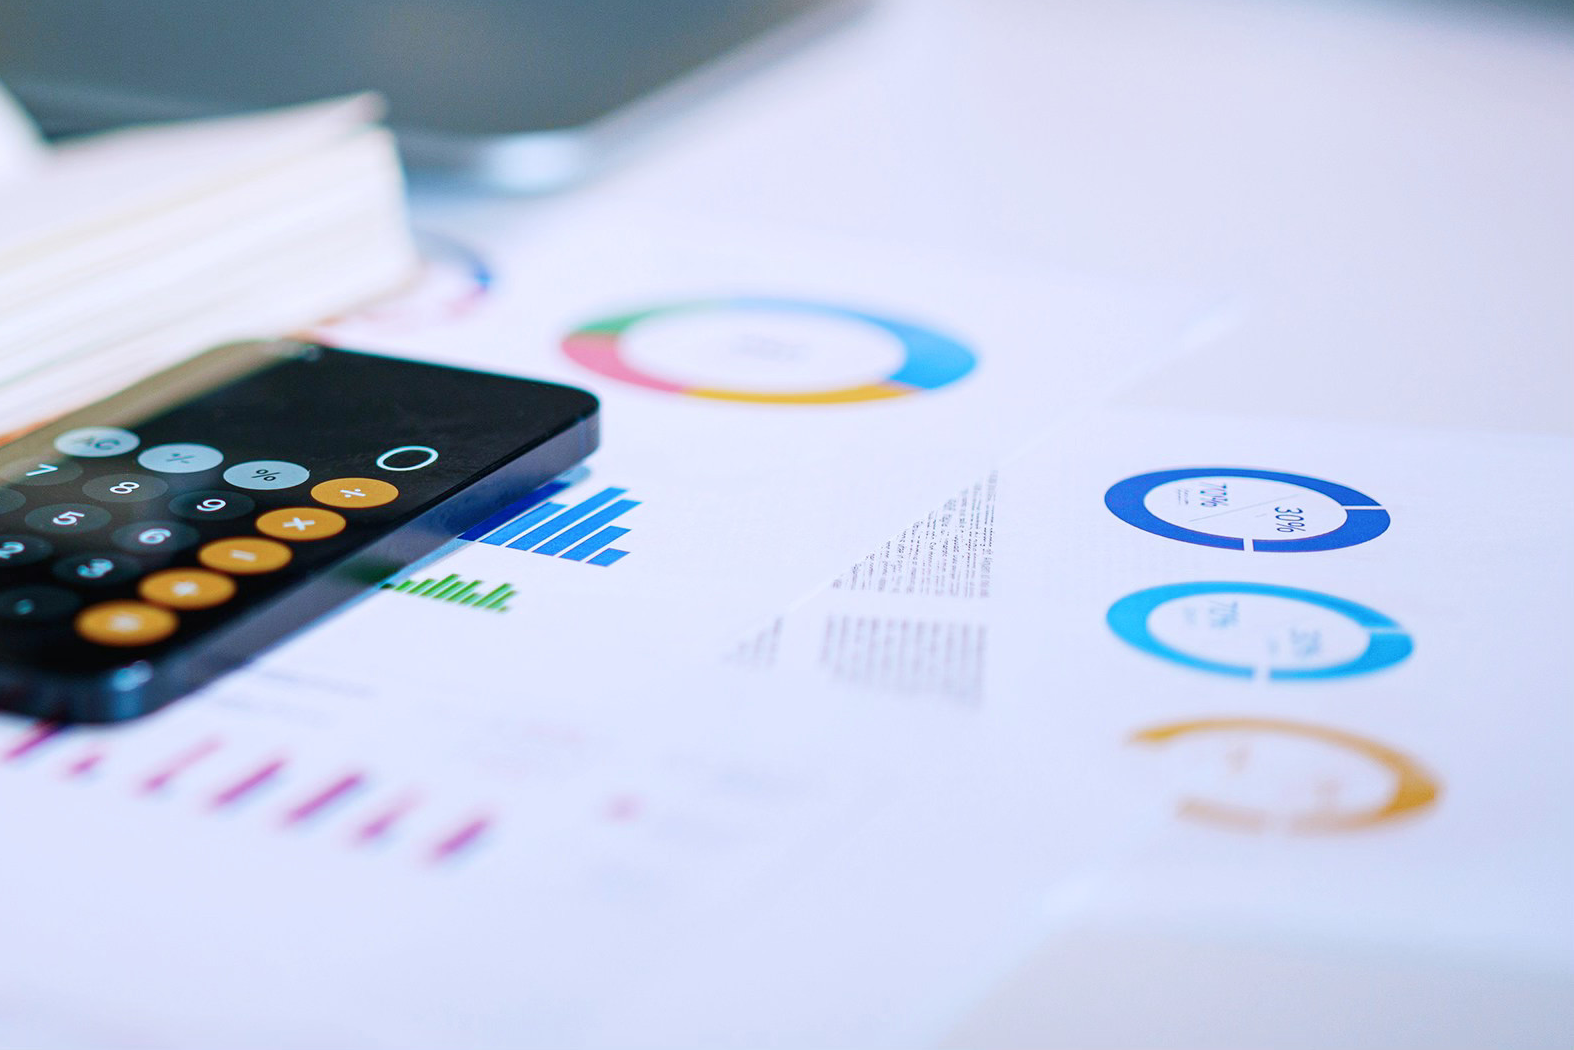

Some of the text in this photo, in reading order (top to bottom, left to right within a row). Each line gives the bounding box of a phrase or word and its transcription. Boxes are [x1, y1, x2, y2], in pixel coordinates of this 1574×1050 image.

[26, 463, 58, 476] 7
[109, 481, 140, 495] 8
[195, 498, 227, 513] 9
[251, 468, 281, 482] %
[1200, 482, 1230, 508] 70%
[52, 511, 85, 526] 5
[138, 527, 172, 544] 6
[1274, 505, 1307, 533] 30%
[76, 558, 114, 579] 3
